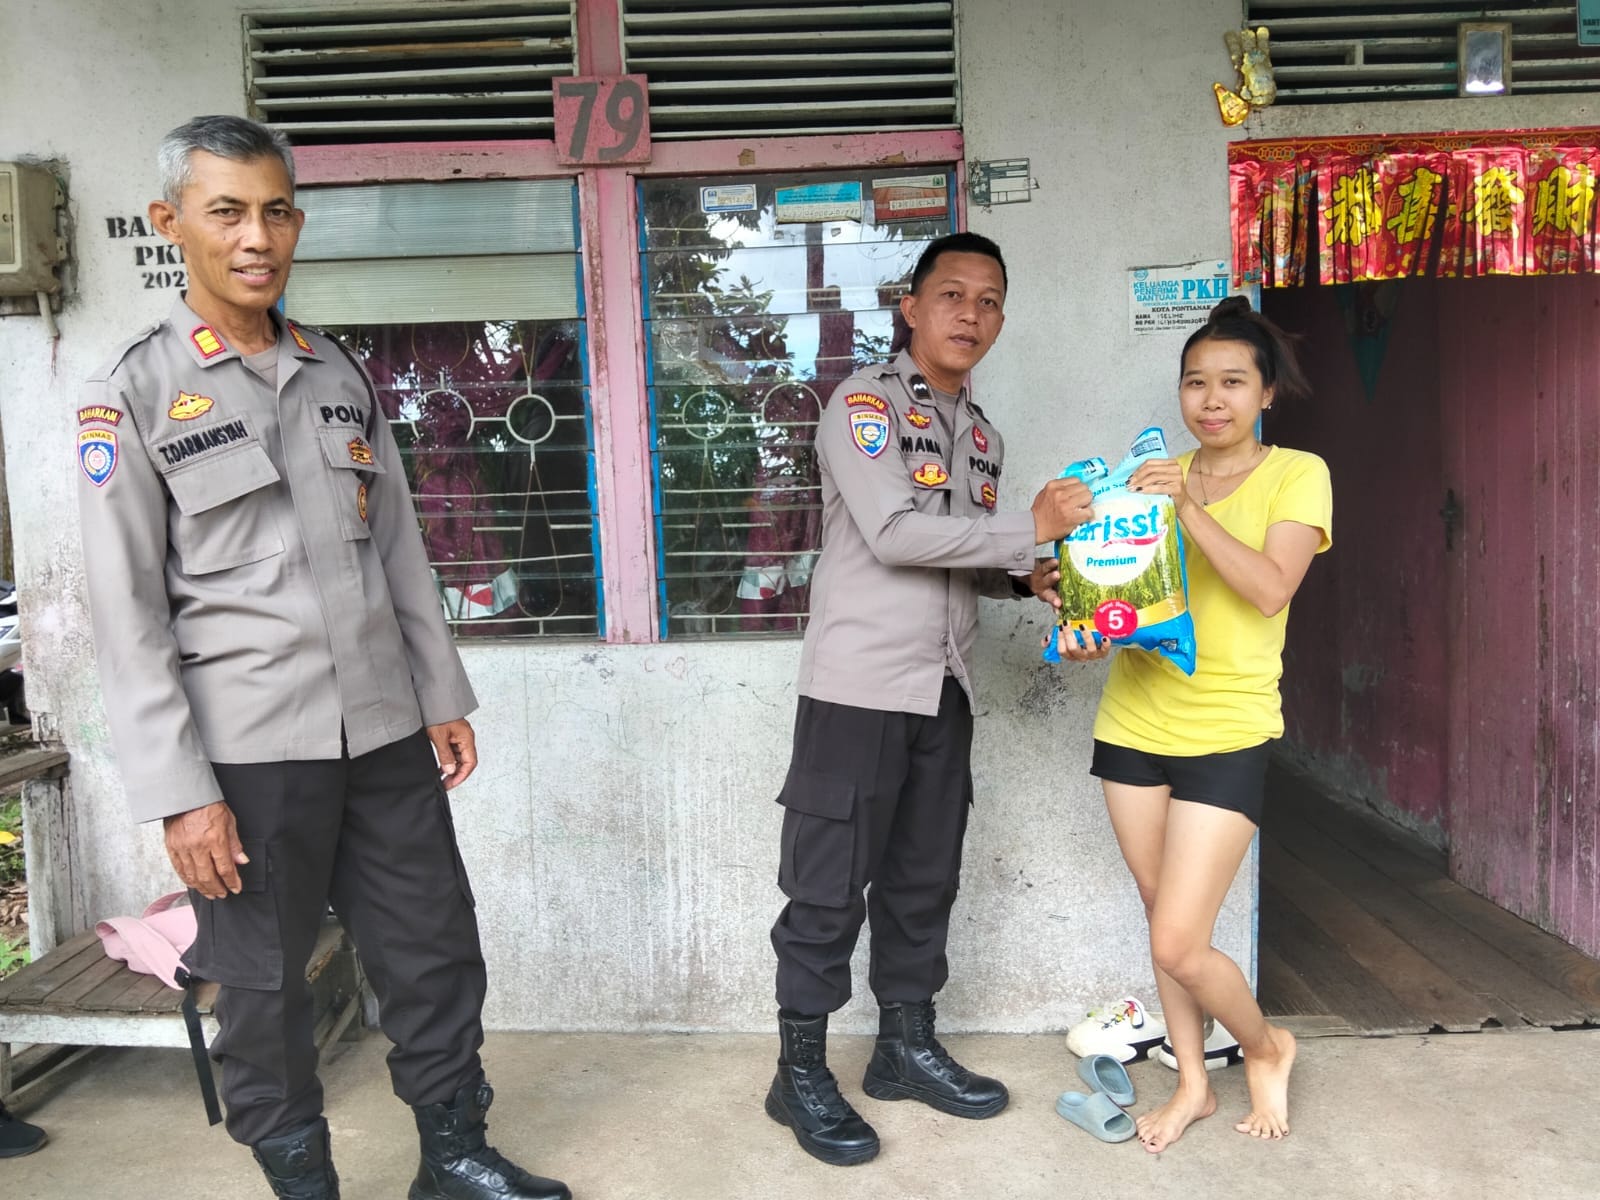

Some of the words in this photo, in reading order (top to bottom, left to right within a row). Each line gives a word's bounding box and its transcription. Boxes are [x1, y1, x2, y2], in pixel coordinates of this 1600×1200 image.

[559, 80, 644, 161] 79
[141, 270, 189, 289] 202
[1133, 280, 1180, 289] KELUARGA
[1134, 287, 1180, 296] PENERIMA
[1181, 277, 1229, 300] PKH
[1136, 293, 1178, 302] BANTUAN
[1151, 305, 1170, 313] KOTA
[1171, 304, 1212, 312] PONTIANAK
[79, 406, 119, 422] BAHARKAM
[159, 420, 248, 466] T.DARMANSYAH
[1086, 555, 1137, 568] Premium
[1108, 609, 1124, 630] 5
